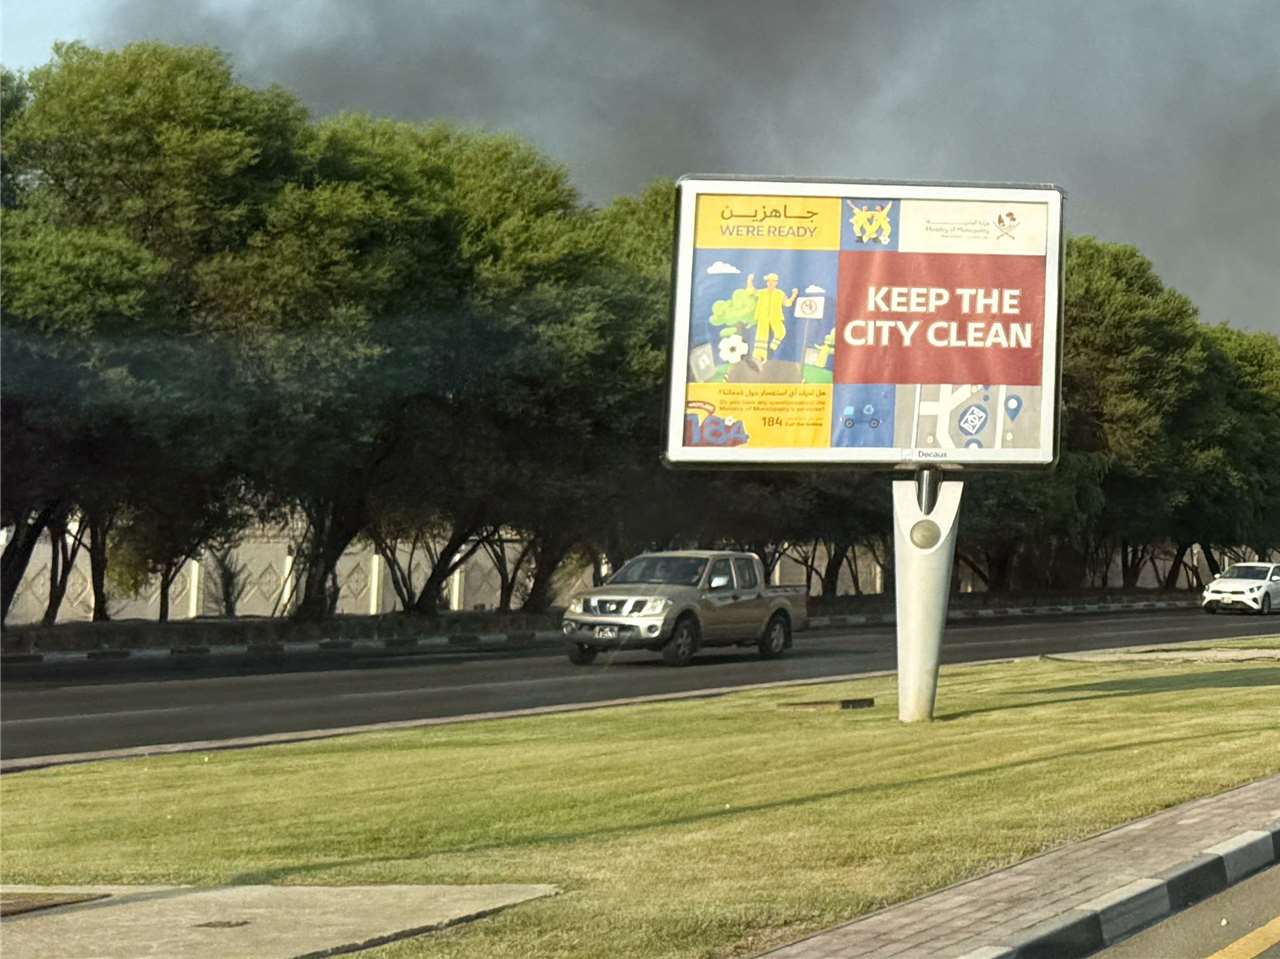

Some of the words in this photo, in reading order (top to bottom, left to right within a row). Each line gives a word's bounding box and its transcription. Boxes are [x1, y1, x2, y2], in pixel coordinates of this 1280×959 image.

[720, 204, 819, 223] جاهزين
[767, 226, 817, 239] READY
[866, 286, 949, 313] KEEP
[955, 288, 1021, 314] THE
[843, 320, 921, 347] CITY
[926, 321, 1033, 348] CLEAN
[762, 416, 783, 427] 184
